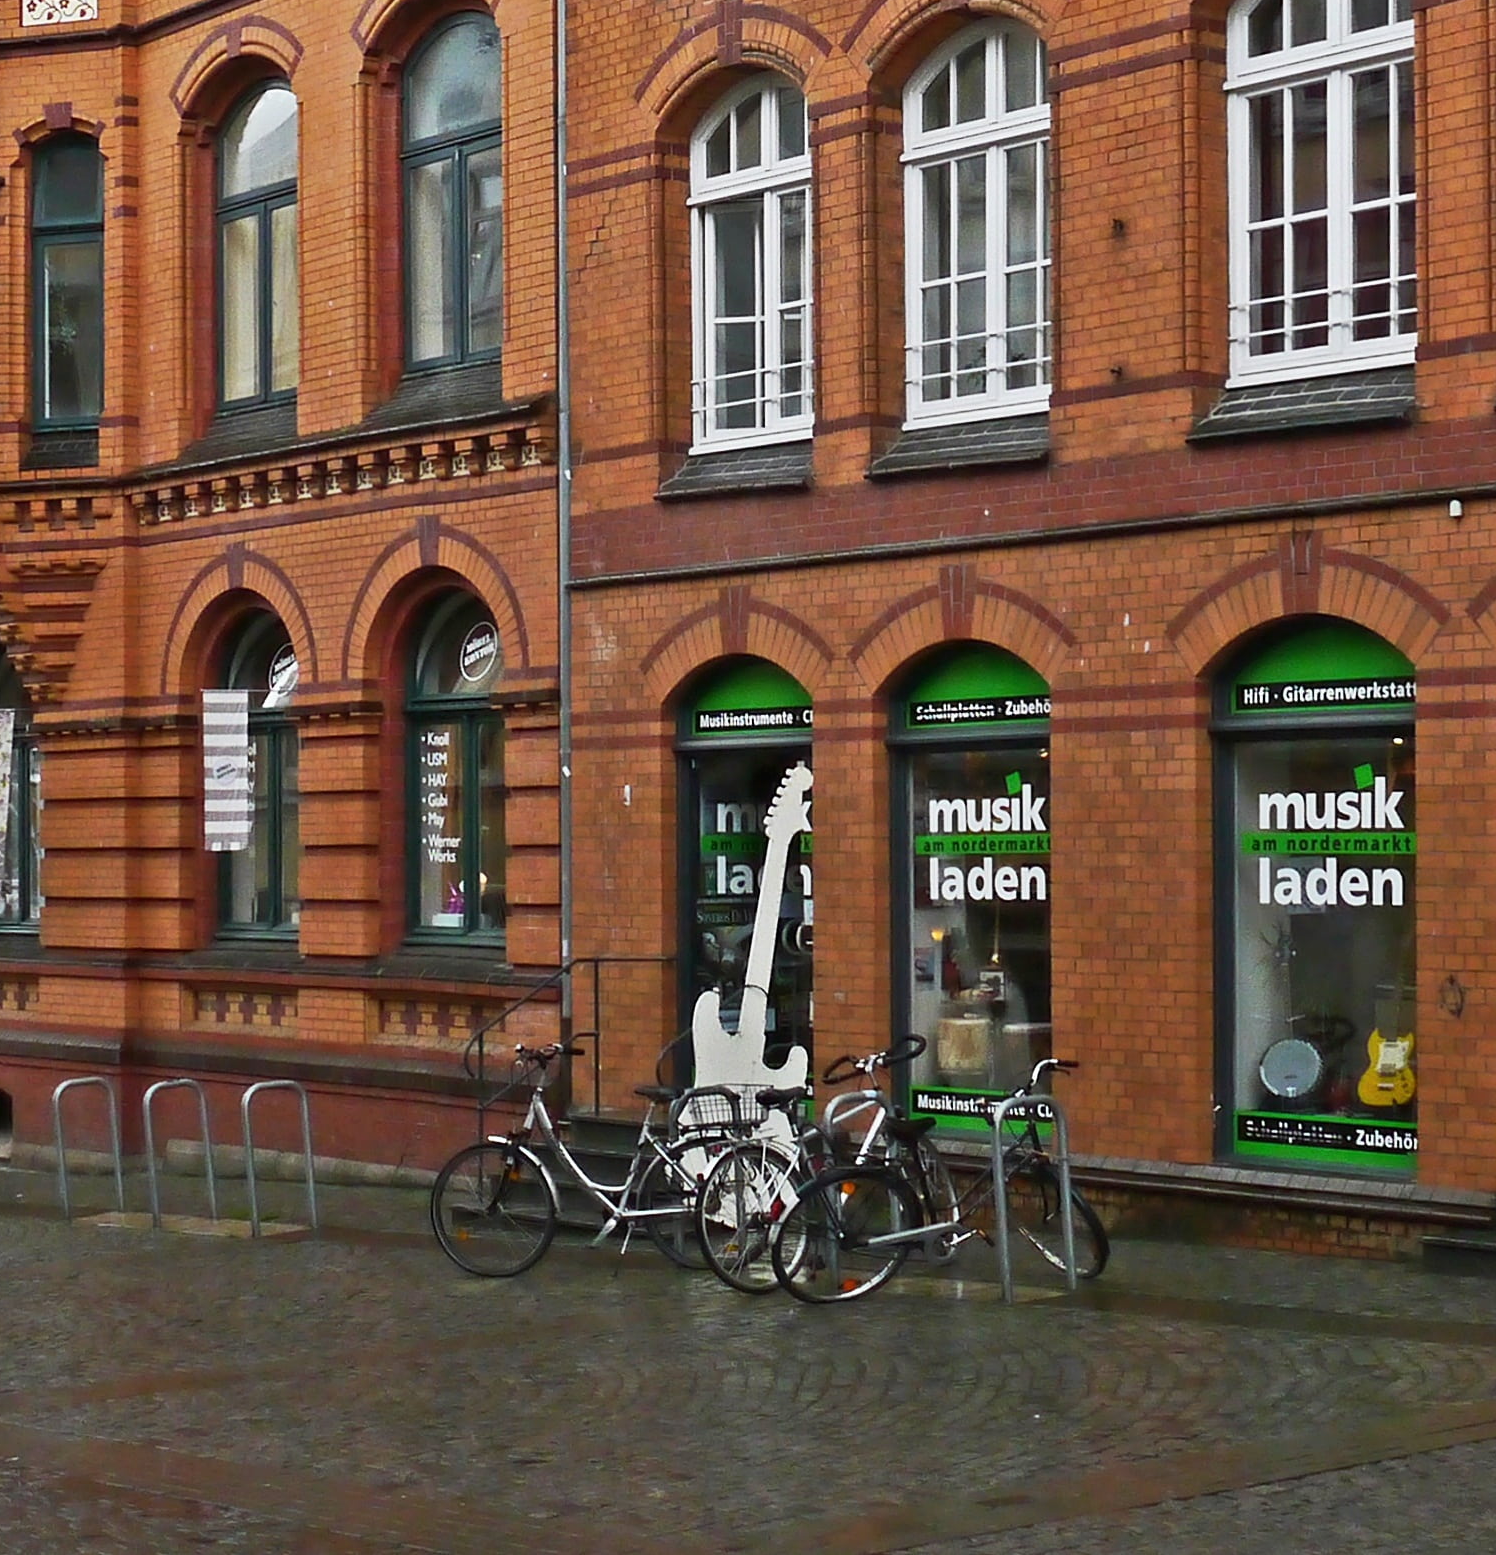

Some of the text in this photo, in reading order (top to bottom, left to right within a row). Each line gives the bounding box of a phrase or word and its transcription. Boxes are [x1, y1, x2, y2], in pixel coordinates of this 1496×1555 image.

[1244, 687, 1269, 704] Hifi
[699, 709, 793, 728] Musikinstrumente
[929, 771, 1046, 833] musik
[1259, 763, 1404, 830] musik
[923, 840, 944, 852] am
[1252, 835, 1411, 851] am nordermarkt
[929, 857, 1046, 901] laden
[1259, 857, 1403, 906] laden
